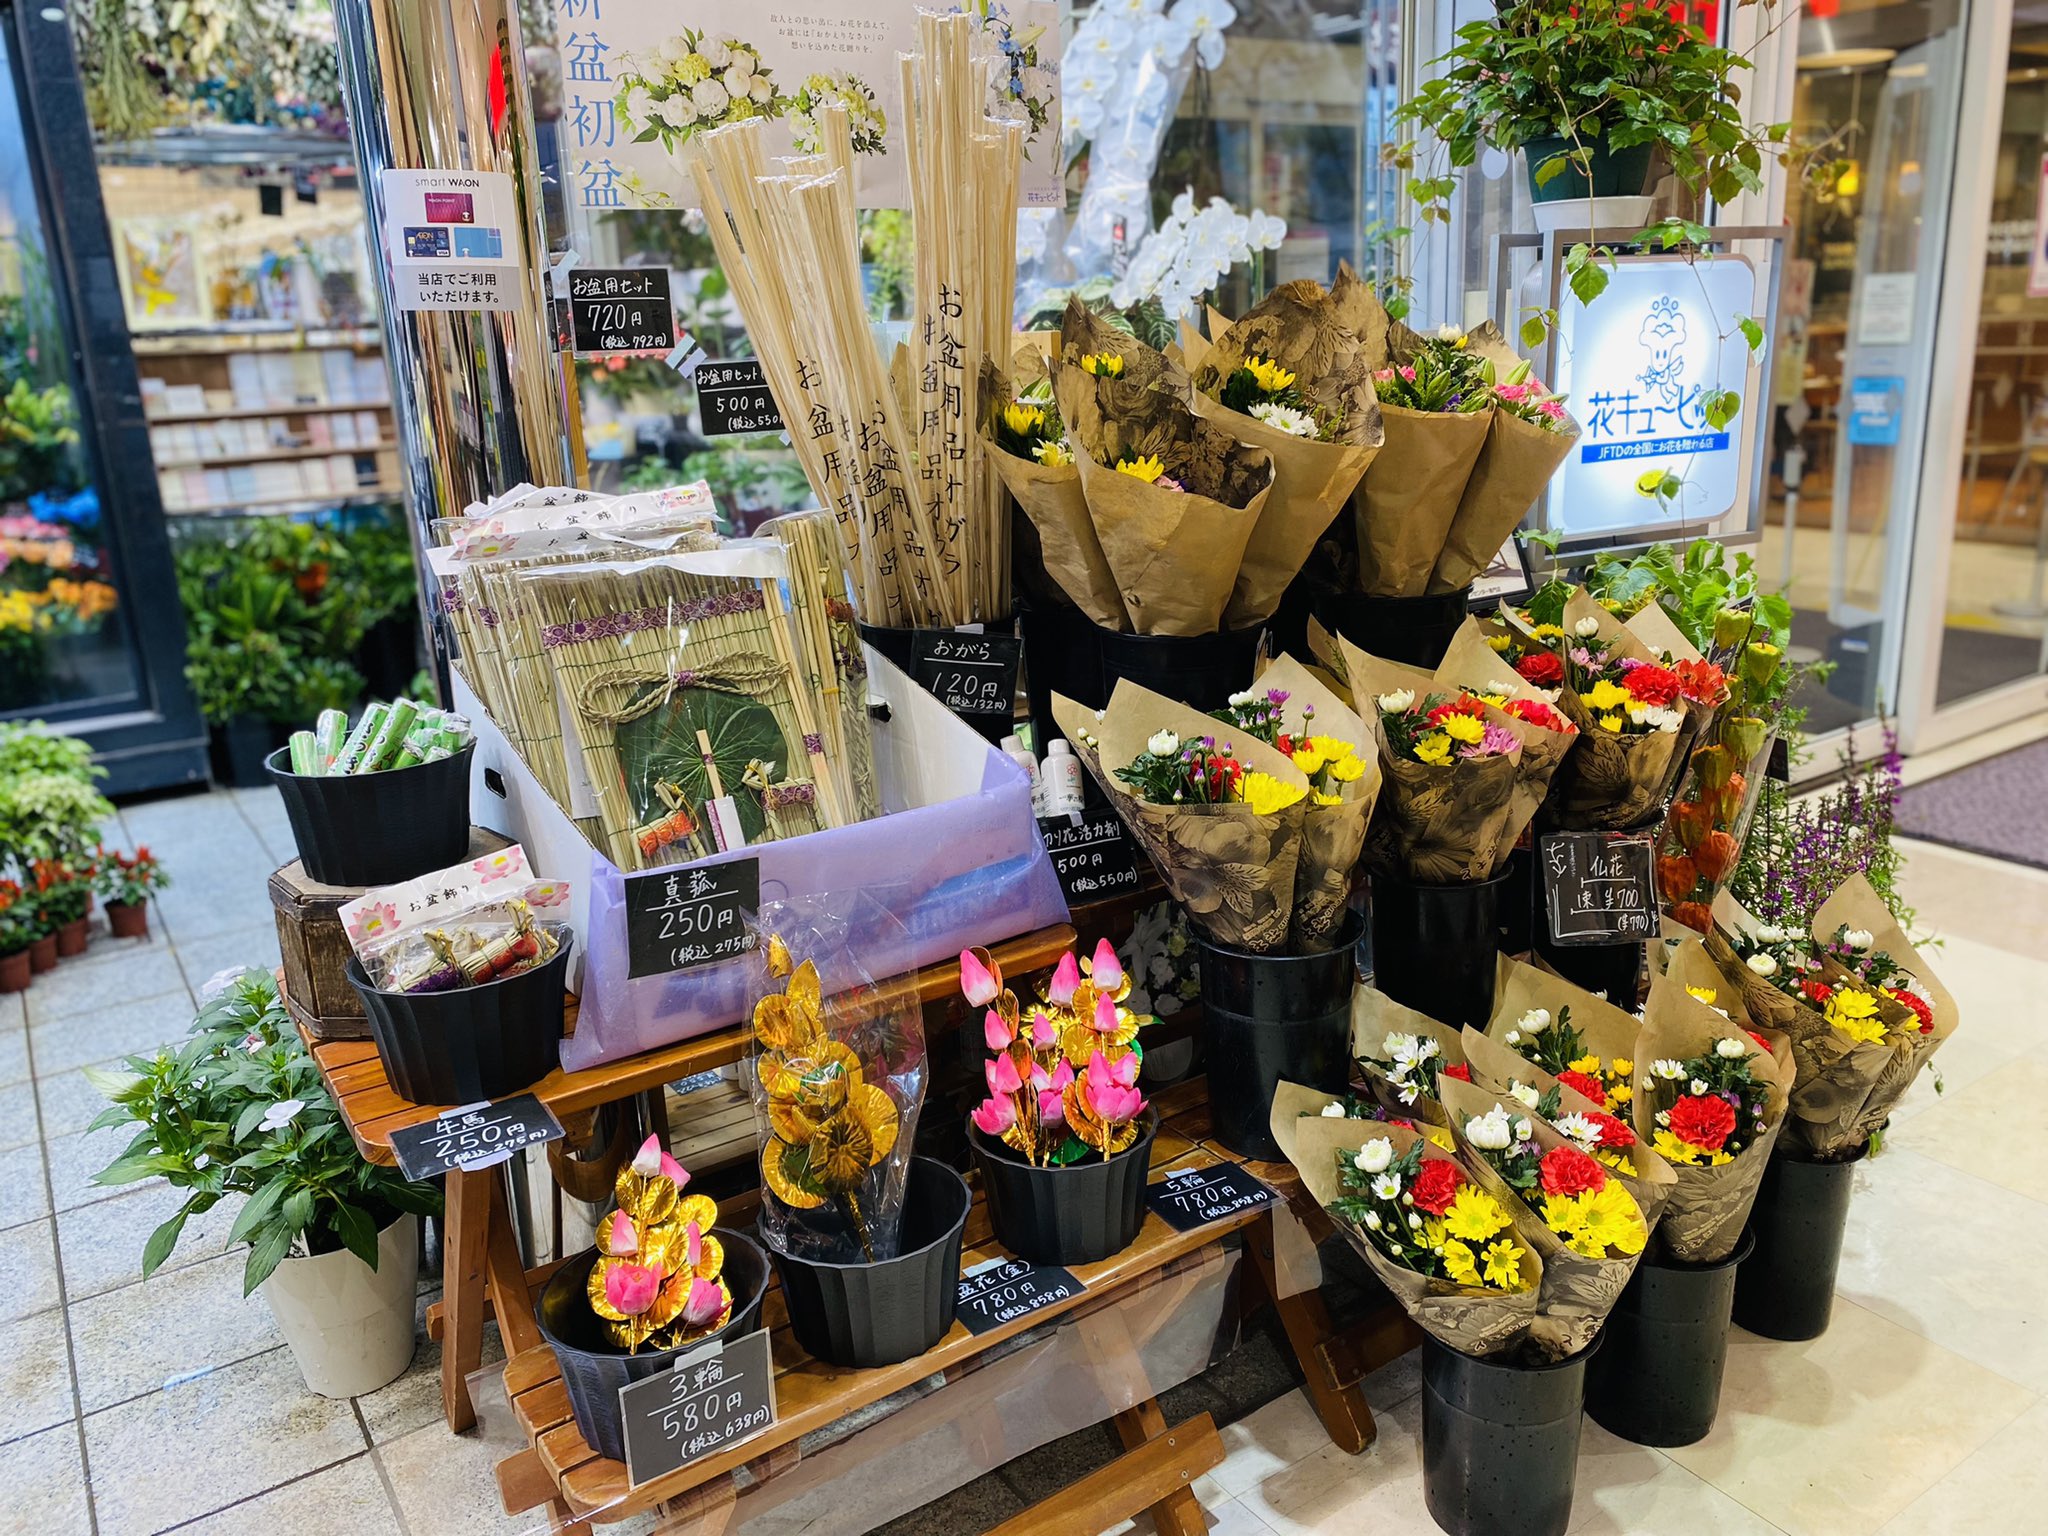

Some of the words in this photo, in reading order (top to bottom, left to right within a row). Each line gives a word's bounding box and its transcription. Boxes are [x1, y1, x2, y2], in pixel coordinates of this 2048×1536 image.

[415, 177, 446, 187] smart
[448, 178, 480, 188] WAON
[418, 273, 497, 286] 当店でご利用
[573, 277, 653, 296] お盆用セット
[420, 290, 499, 304] いただけます。
[588, 303, 642, 331] 720円
[716, 395, 765, 413] 500円
[1588, 383, 1718, 438] 花キューピッ
[728, 414, 783, 432] (税込550
[938, 283, 967, 576] お盆用品オガラ
[933, 638, 991, 660] おがら
[931, 672, 998, 697] 120円
[1058, 852, 1102, 874] 500円
[408, 884, 470, 912] お盆飾り
[664, 869, 717, 907] 真菰
[658, 903, 733, 940] 250円
[435, 1122, 526, 1158] 250円
[1174, 1185, 1237, 1212] 780円
[973, 1281, 1036, 1315] 780円
[669, 1359, 724, 1402] 3輪
[663, 1391, 743, 1440] 580円
